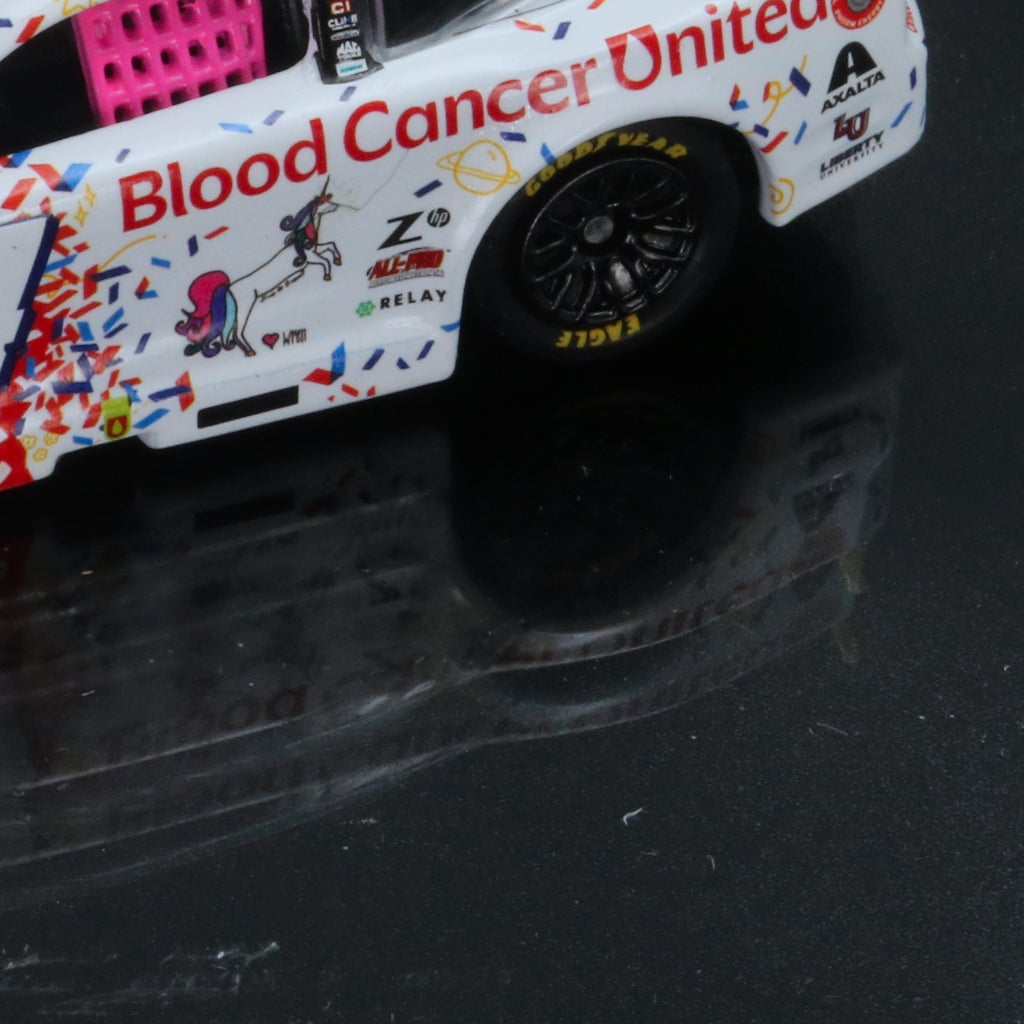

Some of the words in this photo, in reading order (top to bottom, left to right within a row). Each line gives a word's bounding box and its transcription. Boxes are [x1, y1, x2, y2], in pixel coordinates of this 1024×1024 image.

[821, 70, 885, 114] AXALTA
[118, 117, 328, 233] Blood
[343, 58, 597, 163] Cancer
[527, 131, 687, 197] GOODYEAR
[819, 129, 885, 173] LIBERTY
[377, 210, 425, 251] Z
[427, 207, 451, 228] hp
[380, 289, 447, 310] RELAY
[555, 313, 641, 348] EAGLE
